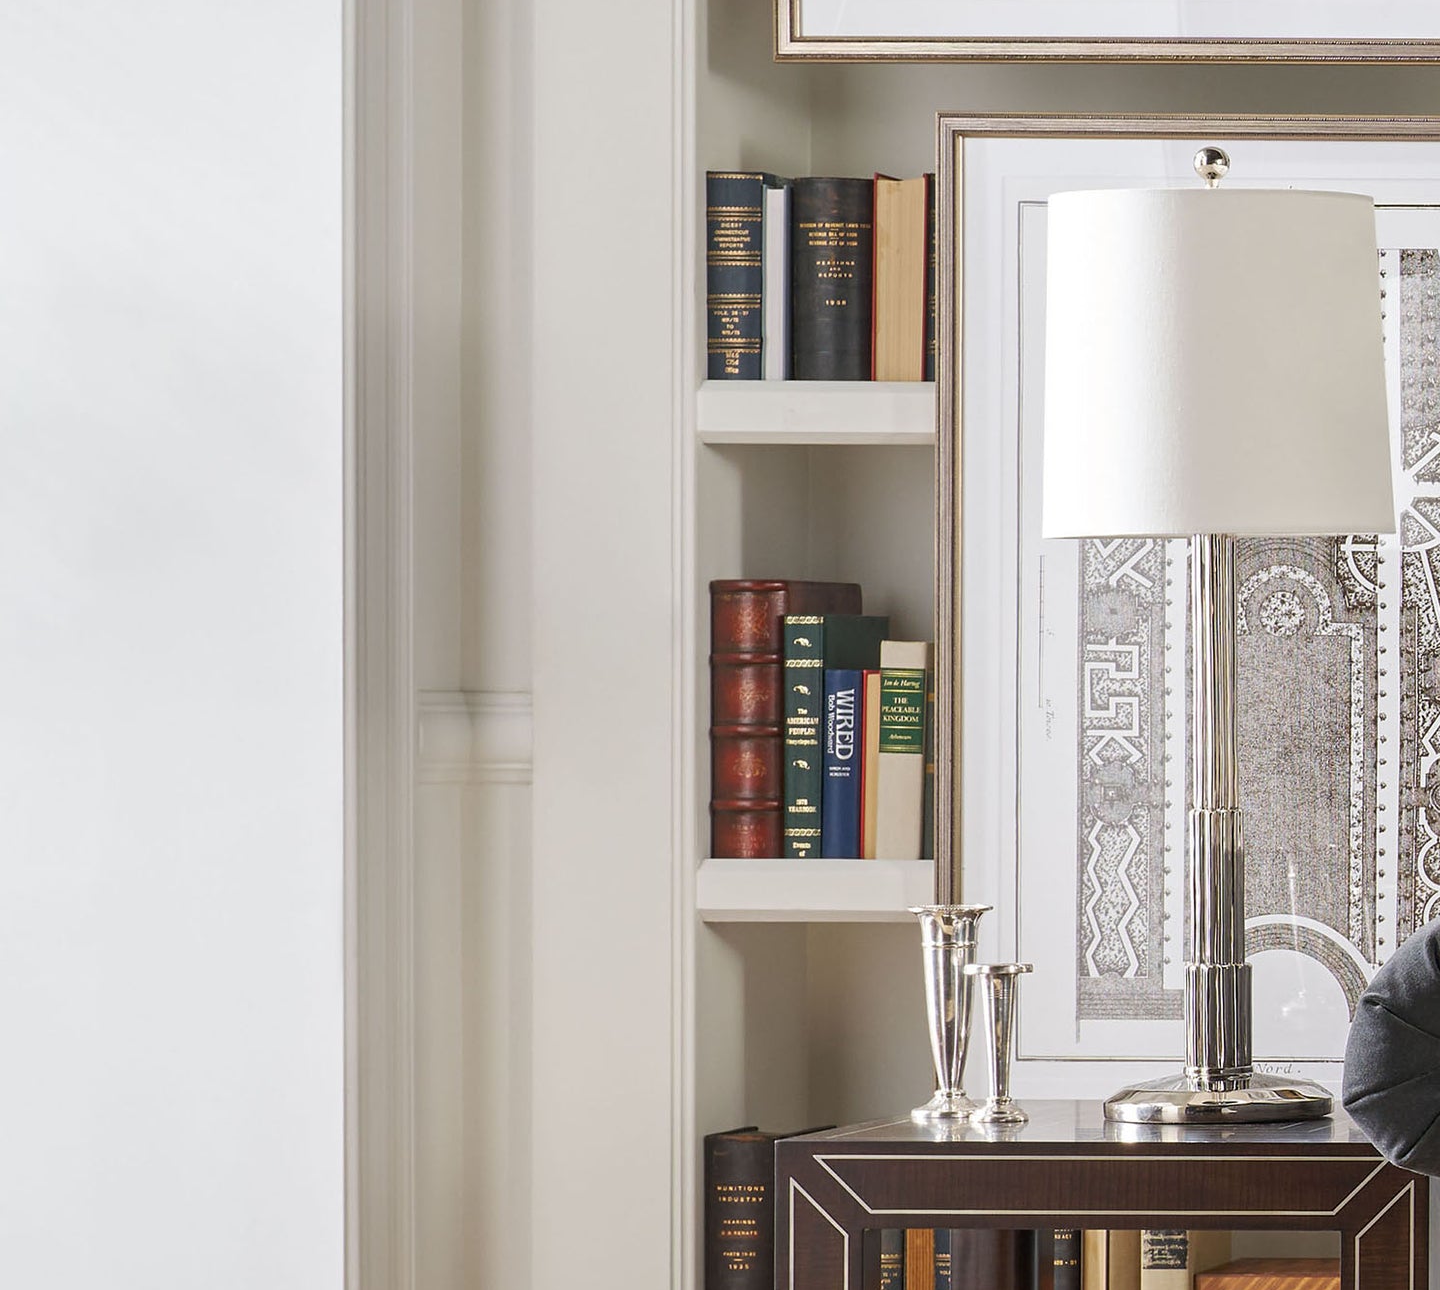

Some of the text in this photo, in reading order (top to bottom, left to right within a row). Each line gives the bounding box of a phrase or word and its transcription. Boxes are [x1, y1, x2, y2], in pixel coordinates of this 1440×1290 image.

[786, 717, 819, 725] AMERICAN
[883, 715, 919, 723] KINGDOM
[827, 695, 836, 754] Bob Woodward
[836, 689, 855, 761] WIRED
[788, 727, 816, 735] PEOPLES
